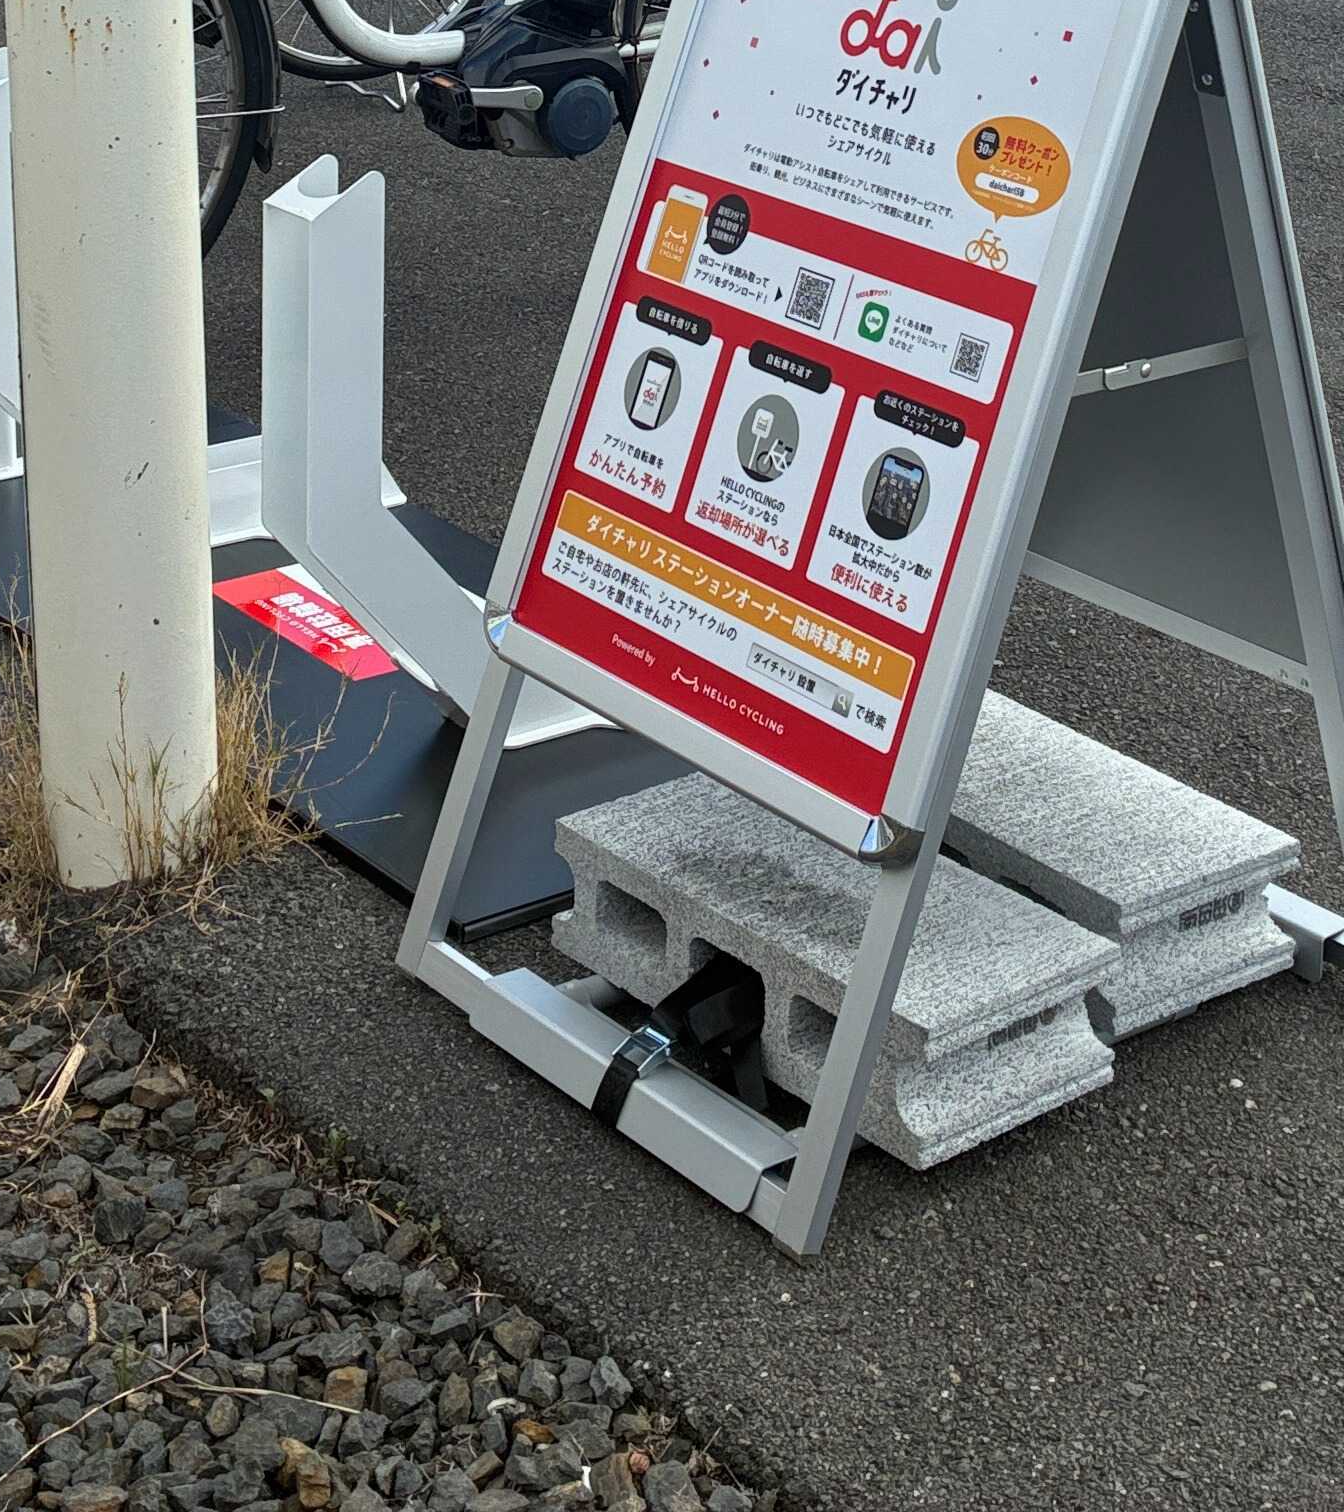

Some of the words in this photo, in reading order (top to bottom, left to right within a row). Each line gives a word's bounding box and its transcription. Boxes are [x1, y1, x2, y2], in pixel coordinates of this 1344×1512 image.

[835, 68, 917, 115] ダイチャリ
[793, 99, 938, 160] いつでもどこでも気軽に使える
[1003, 133, 1061, 163] 無料クーポン
[825, 133, 894, 168] シェアサイクル
[999, 150, 1054, 177] プレゼント！
[660, 239, 685, 255] HELLO
[693, 268, 768, 305] アプリをダウンロード！
[697, 253, 769, 289] QRコードを読み取って
[647, 305, 699, 335] 自転車を借りる
[891, 325, 947, 353] ダイチャリについて
[888, 337, 913, 353] などなど
[764, 352, 813, 381] 自転車を返す
[882, 393, 960, 433] お近くのステーションを
[900, 414, 935, 436] チェック！
[603, 432, 664, 469] アプリで自転車を
[588, 448, 667, 500] かんたん予約
[715, 488, 779, 527] ステーションなら
[720, 475, 746, 496] HELLO
[744, 486, 785, 514] CYCLINGの
[694, 498, 792, 559] 返却場所が選べる
[827, 524, 933, 581] 日本全国でステーション数が
[851, 551, 901, 583] 拡大中だから
[550, 556, 683, 636] ステーションを置きませんか？
[556, 538, 739, 643] ご自宅やお店の軒先に、シェアサイクルの
[584, 512, 652, 561] ダイチャリ
[651, 545, 885, 678] ステーションオーナー随時募集中！
[829, 562, 910, 614] 便利に使える
[610, 632, 645, 660] Powered
[642, 649, 656, 668] by
[701, 682, 738, 711] HELLO
[737, 702, 785, 737] CYCLING
[752, 651, 797, 684] ダイチャリ
[795, 673, 817, 694] 設置
[852, 701, 888, 733] で検索
